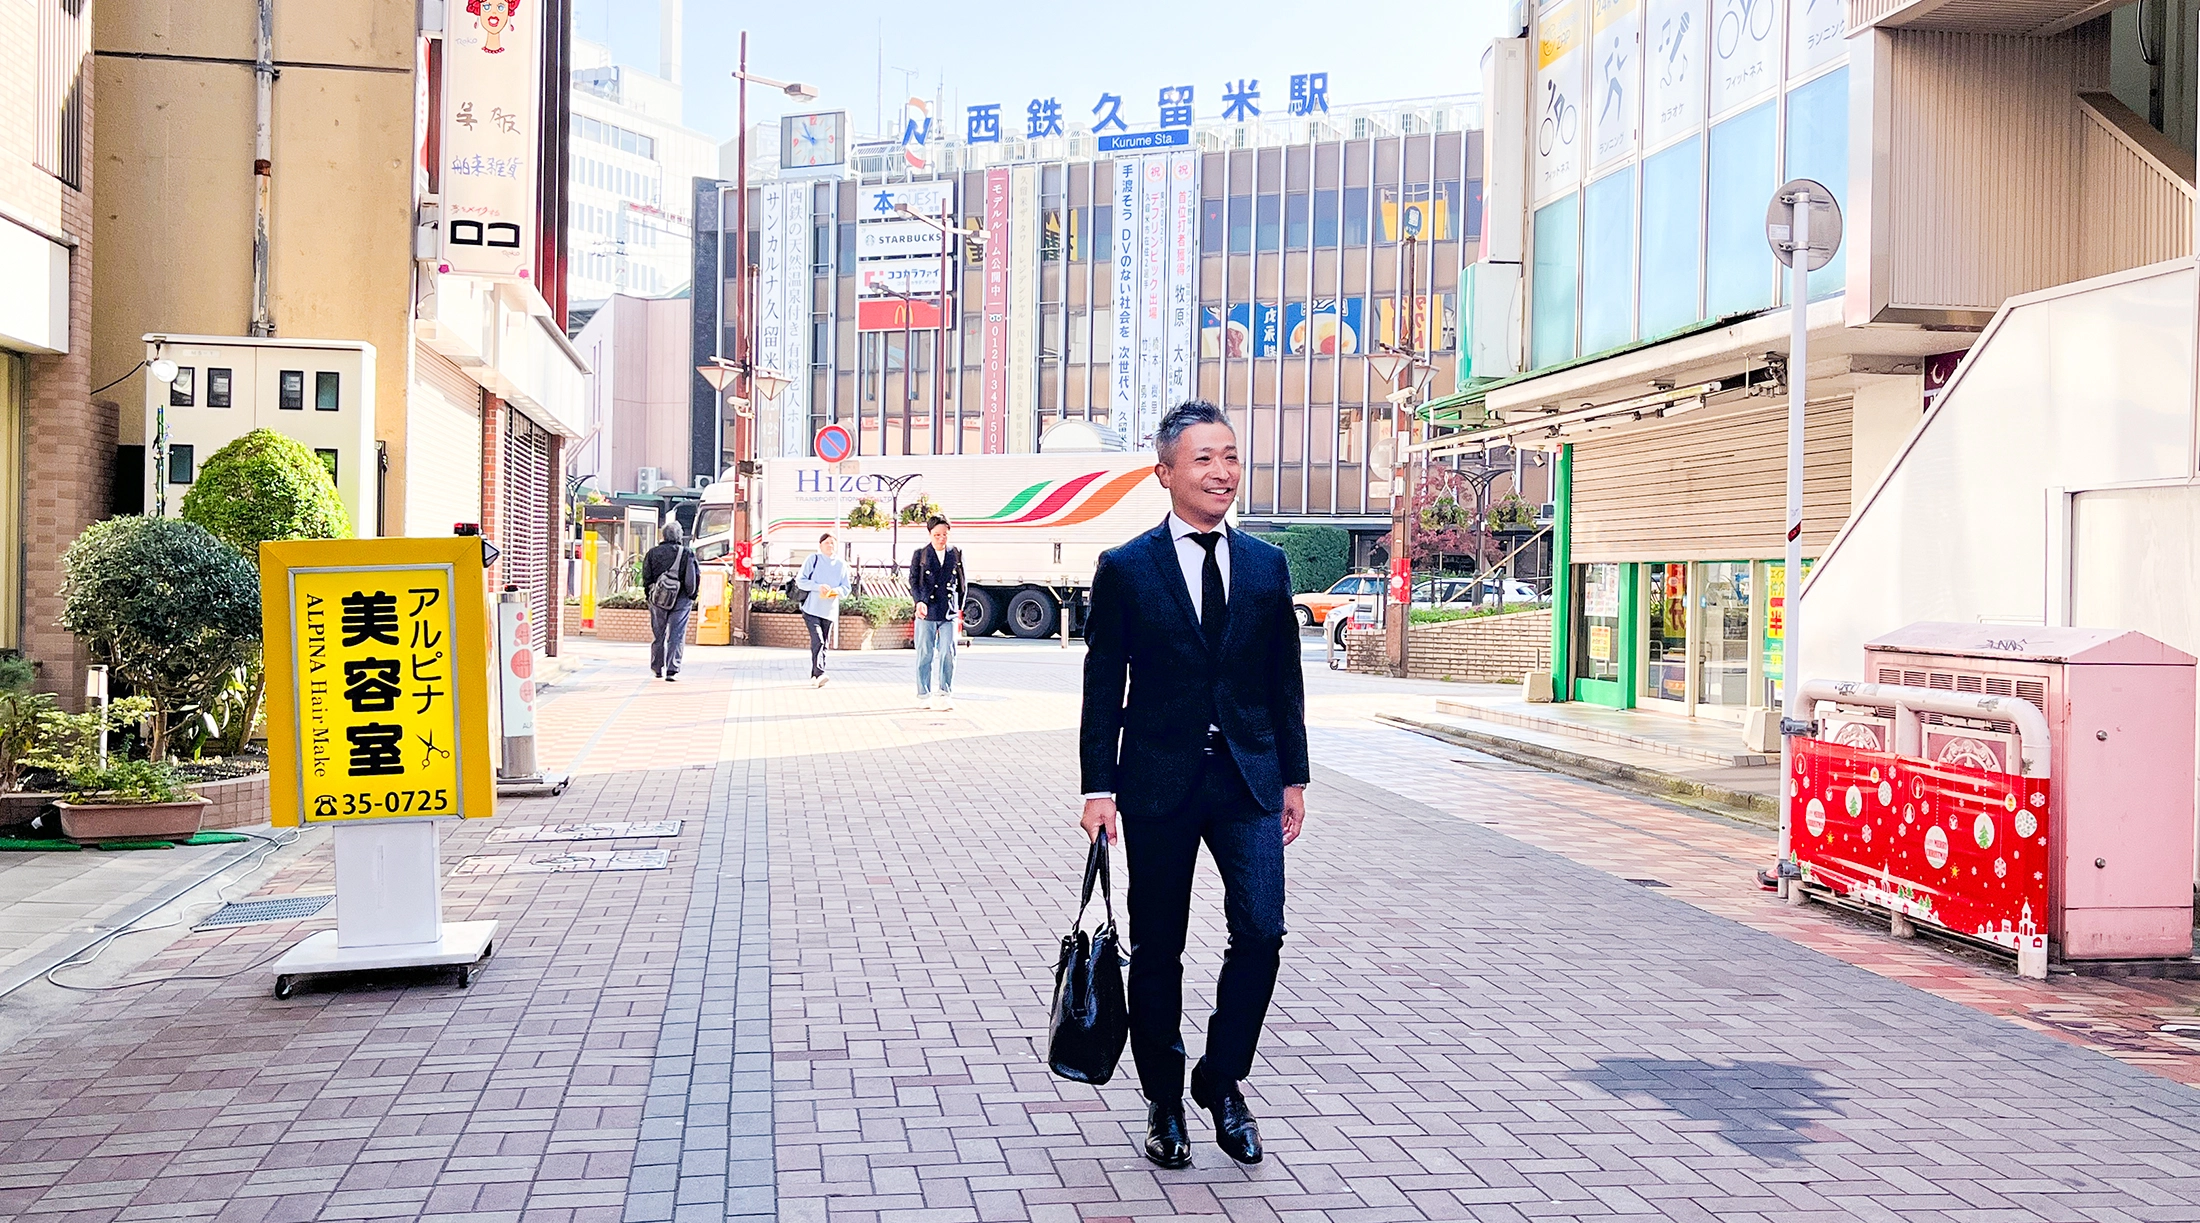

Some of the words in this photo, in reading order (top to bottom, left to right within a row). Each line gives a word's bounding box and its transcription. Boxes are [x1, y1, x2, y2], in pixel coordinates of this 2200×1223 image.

[1726, 61, 1763, 90] フィットネス
[966, 72, 1330, 144] 西鉄久留米駅
[1661, 103, 1684, 124] カラオケ
[1111, 134, 1152, 148] Kurume
[1154, 132, 1176, 146] Sta.
[1599, 131, 1624, 155] ランニング
[1151, 167, 1160, 177] 祝
[1178, 164, 1188, 175] 祝
[1544, 161, 1570, 183] フィットネス
[873, 190, 894, 214] 本
[897, 191, 939, 206] QUEST
[1122, 164, 1133, 220] 手渡そう
[450, 220, 520, 248] ロコ
[878, 232, 942, 245] STARBUCKS
[990, 184, 1004, 297] モデルルーム公開中
[888, 268, 940, 280] ココカラファイ
[1149, 192, 1160, 320] デフリンピック出場
[764, 192, 780, 370] サンカルナ久留米
[1120, 228, 1132, 338] DVのない社会を
[990, 326, 998, 454] 0120-343-505
[1118, 346, 1130, 401] 次世代へ
[306, 594, 326, 674] ALPINA
[408, 588, 444, 714] アルピナ
[341, 590, 405, 777] 美容室
[309, 682, 329, 725] Hair
[312, 728, 331, 778] Make
[342, 790, 448, 815] 35-0725
